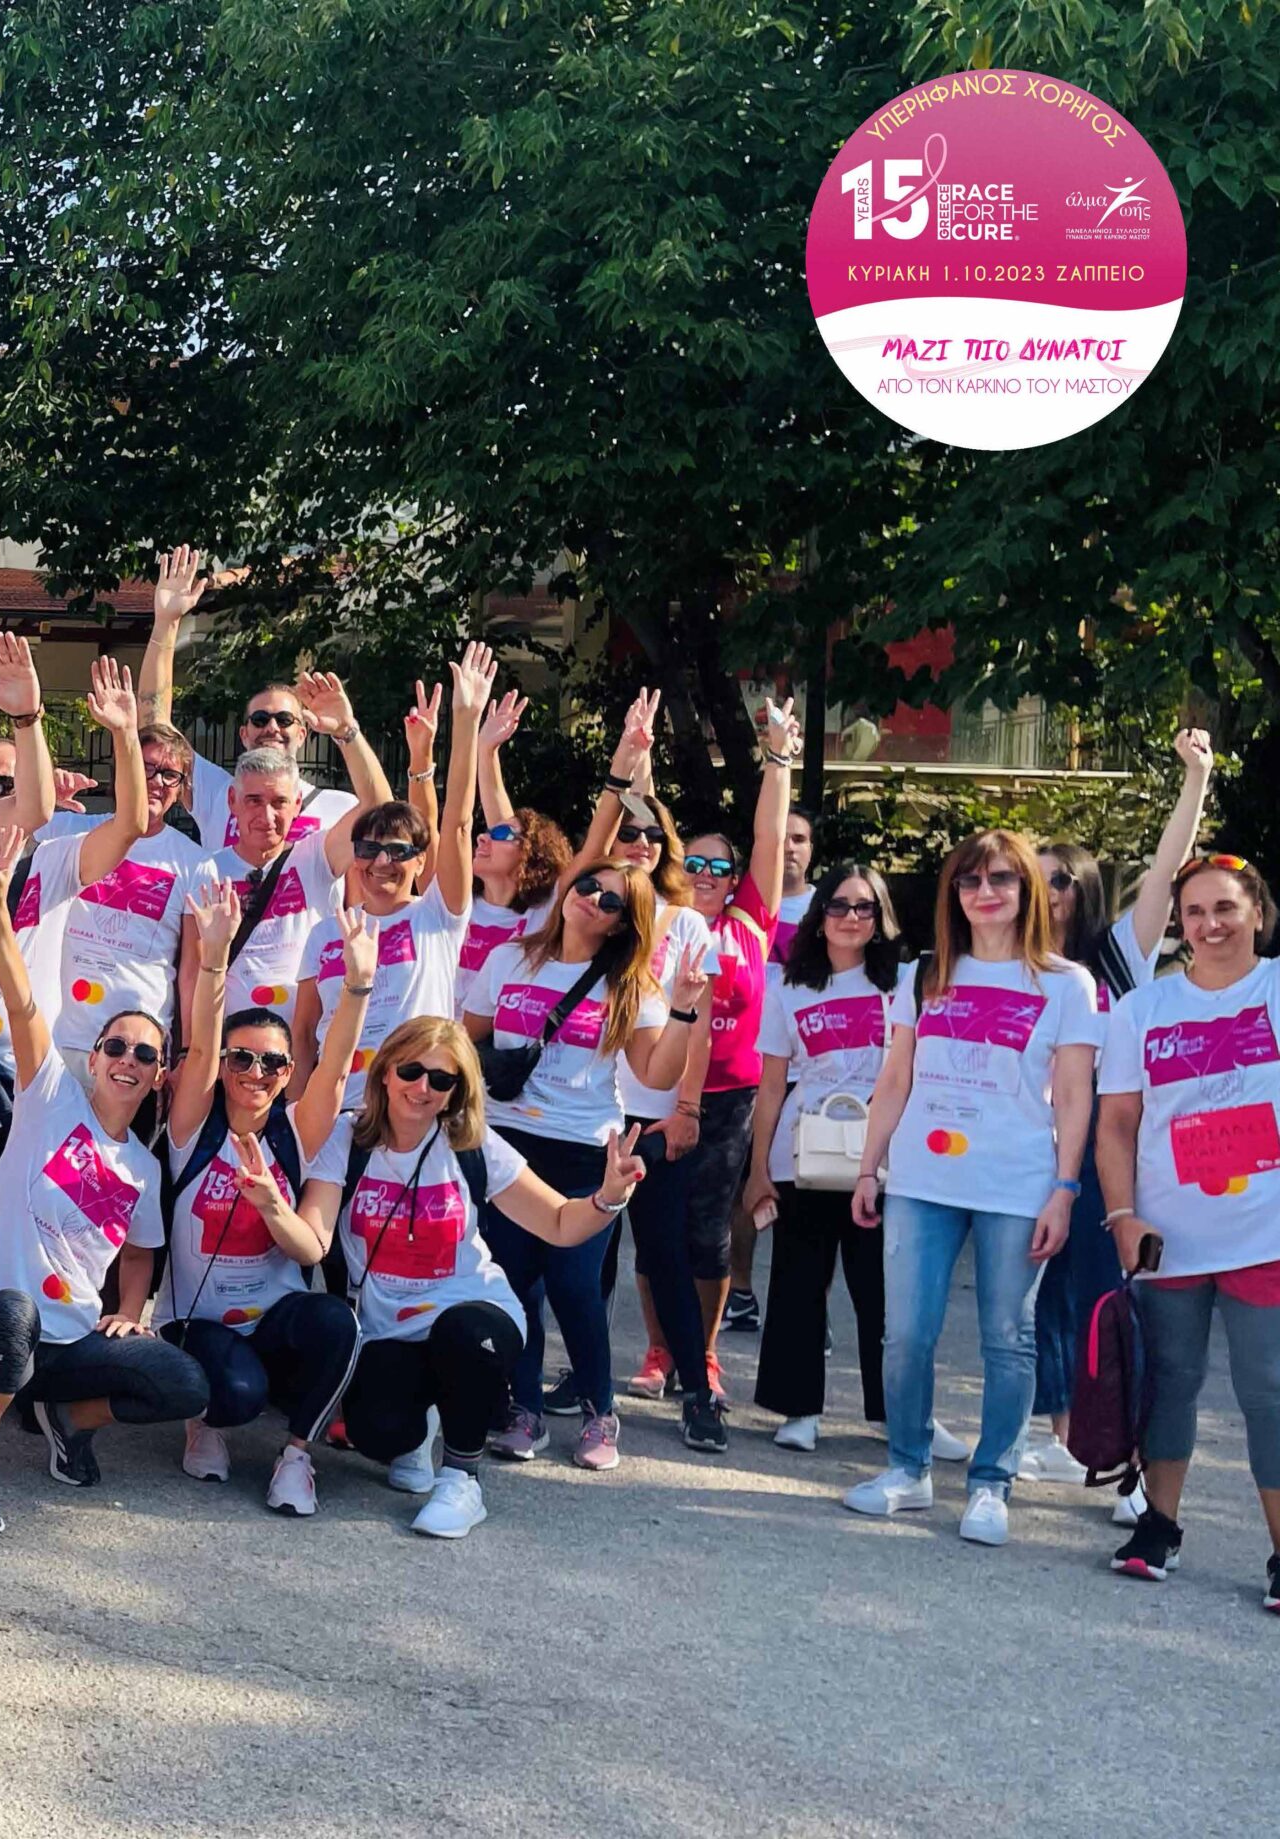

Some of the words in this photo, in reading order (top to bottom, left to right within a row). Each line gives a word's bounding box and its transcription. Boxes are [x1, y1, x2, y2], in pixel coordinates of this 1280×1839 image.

[229, 818, 241, 837] 1
[711, 1016, 738, 1031] OR
[800, 1011, 824, 1037] 15
[1147, 1037, 1176, 1063] 15
[204, 1170, 229, 1200] 15
[356, 1190, 379, 1217] 15
